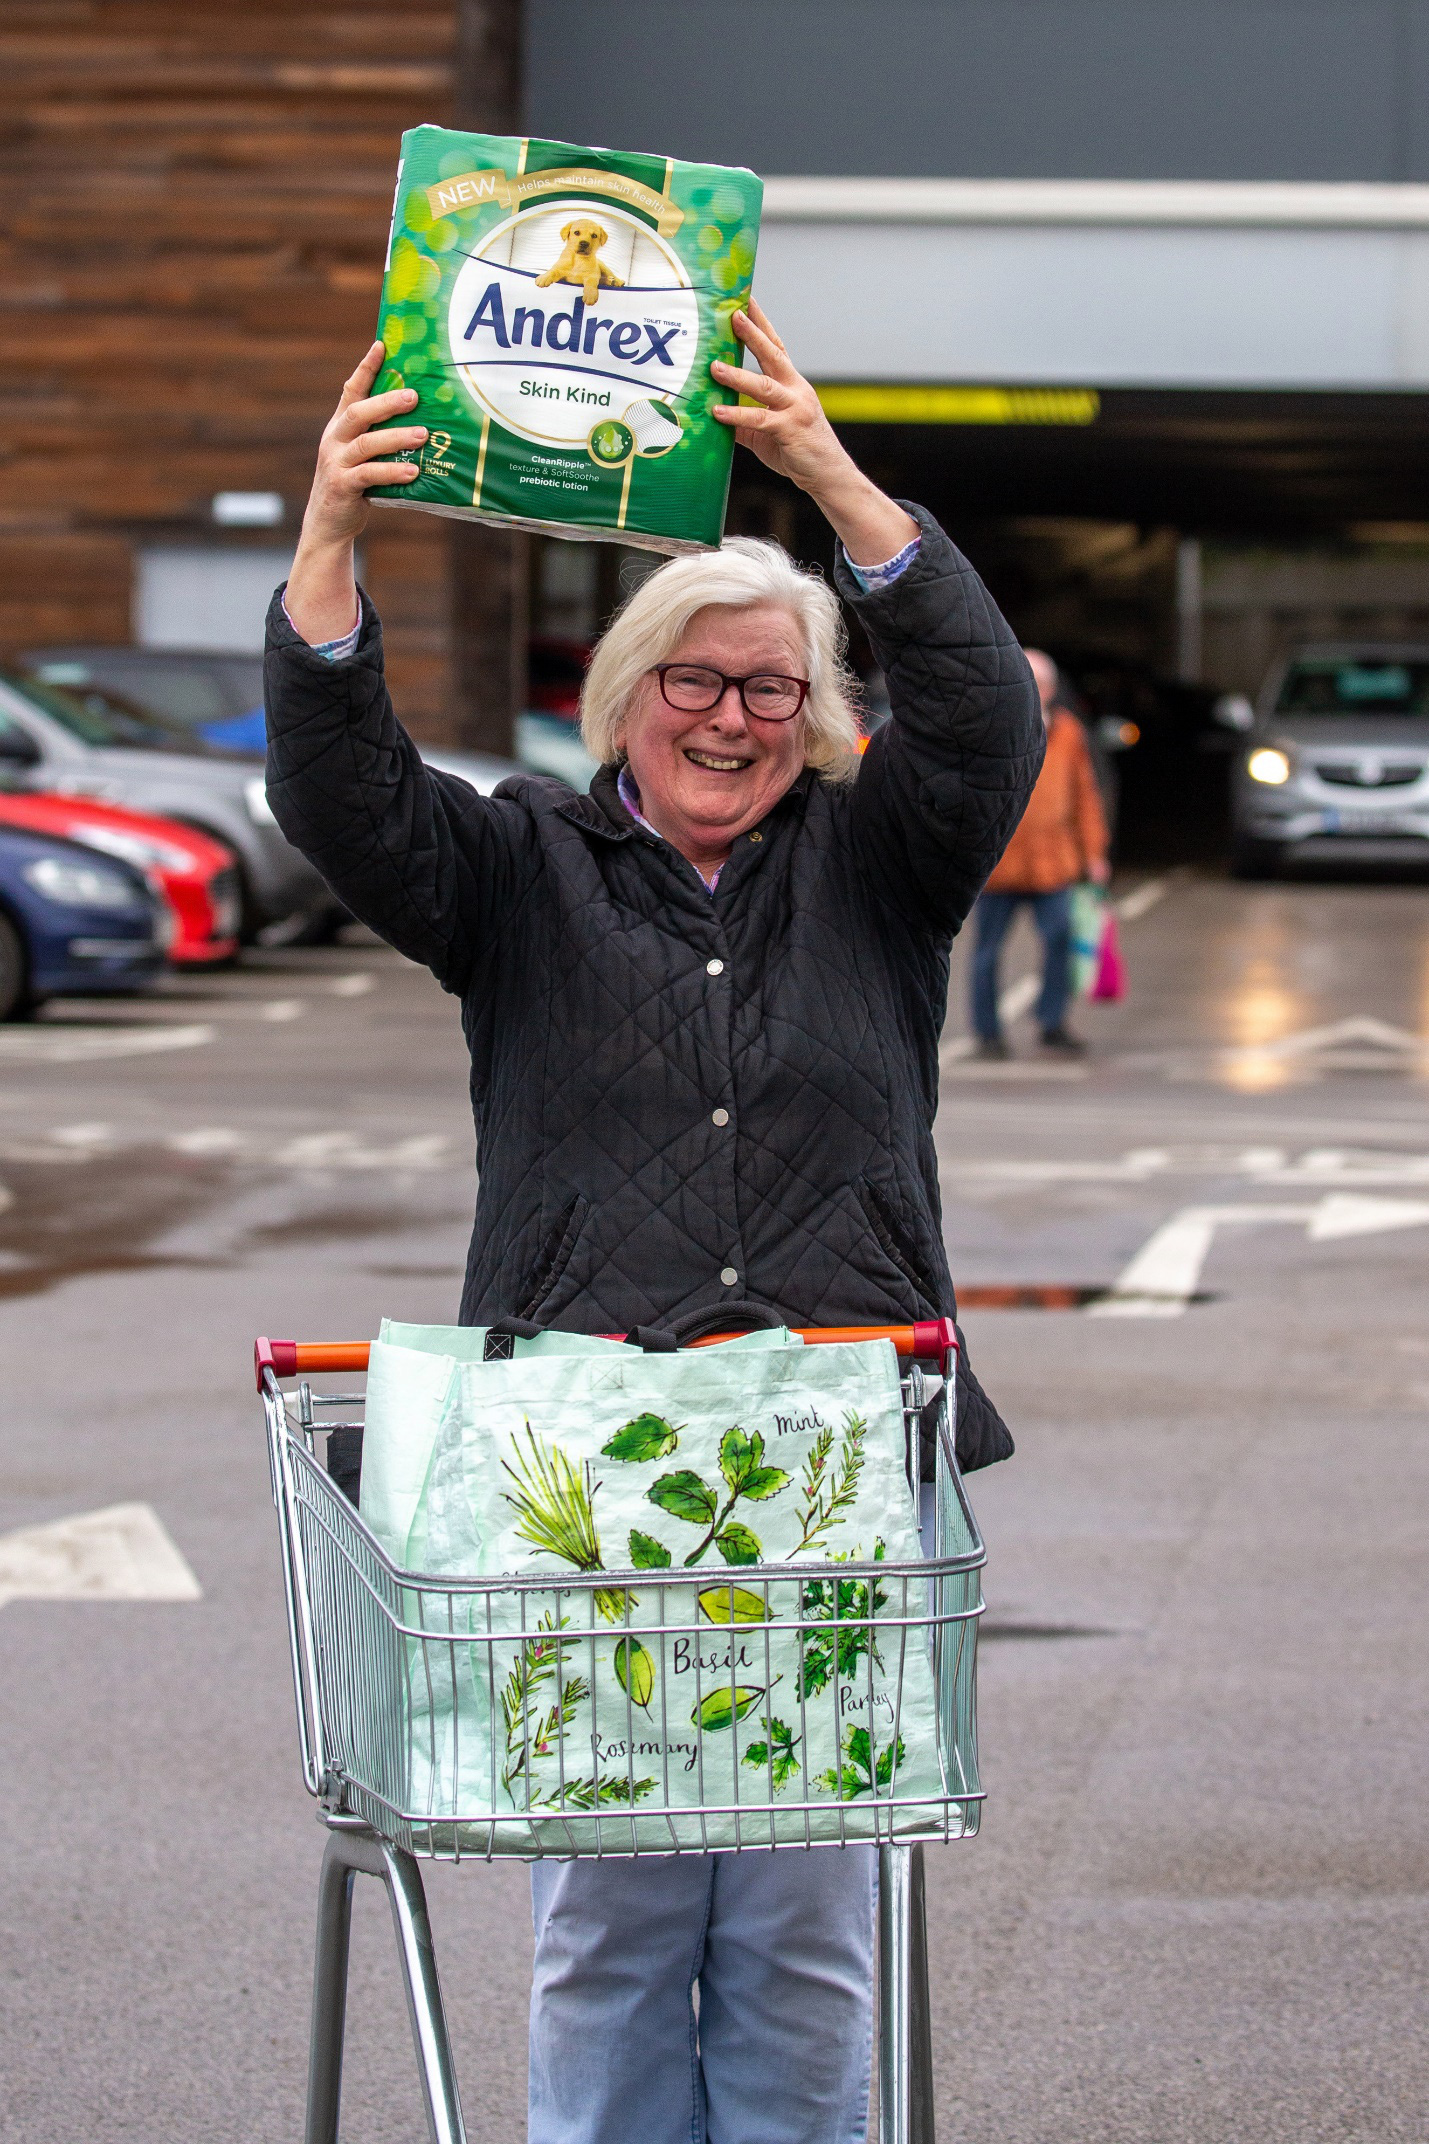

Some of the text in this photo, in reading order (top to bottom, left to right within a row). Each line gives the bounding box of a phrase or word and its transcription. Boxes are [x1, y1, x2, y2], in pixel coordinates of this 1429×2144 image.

[437, 176, 496, 208] NEW
[517, 175, 666, 215] Helps maintain skin health
[643, 317, 681, 328] TOILET TISSUE
[519, 380, 611, 407] Skin Kind
[430, 430, 452, 459] 9
[425, 459, 456, 470] LUXURY
[425, 467, 449, 477] ROLLS
[509, 463, 600, 482] texture & SoftSoothe
[519, 476, 589, 491] prebiotic lotion
[673, 1637, 753, 1675] Basil
[840, 1682, 895, 1724] Parley
